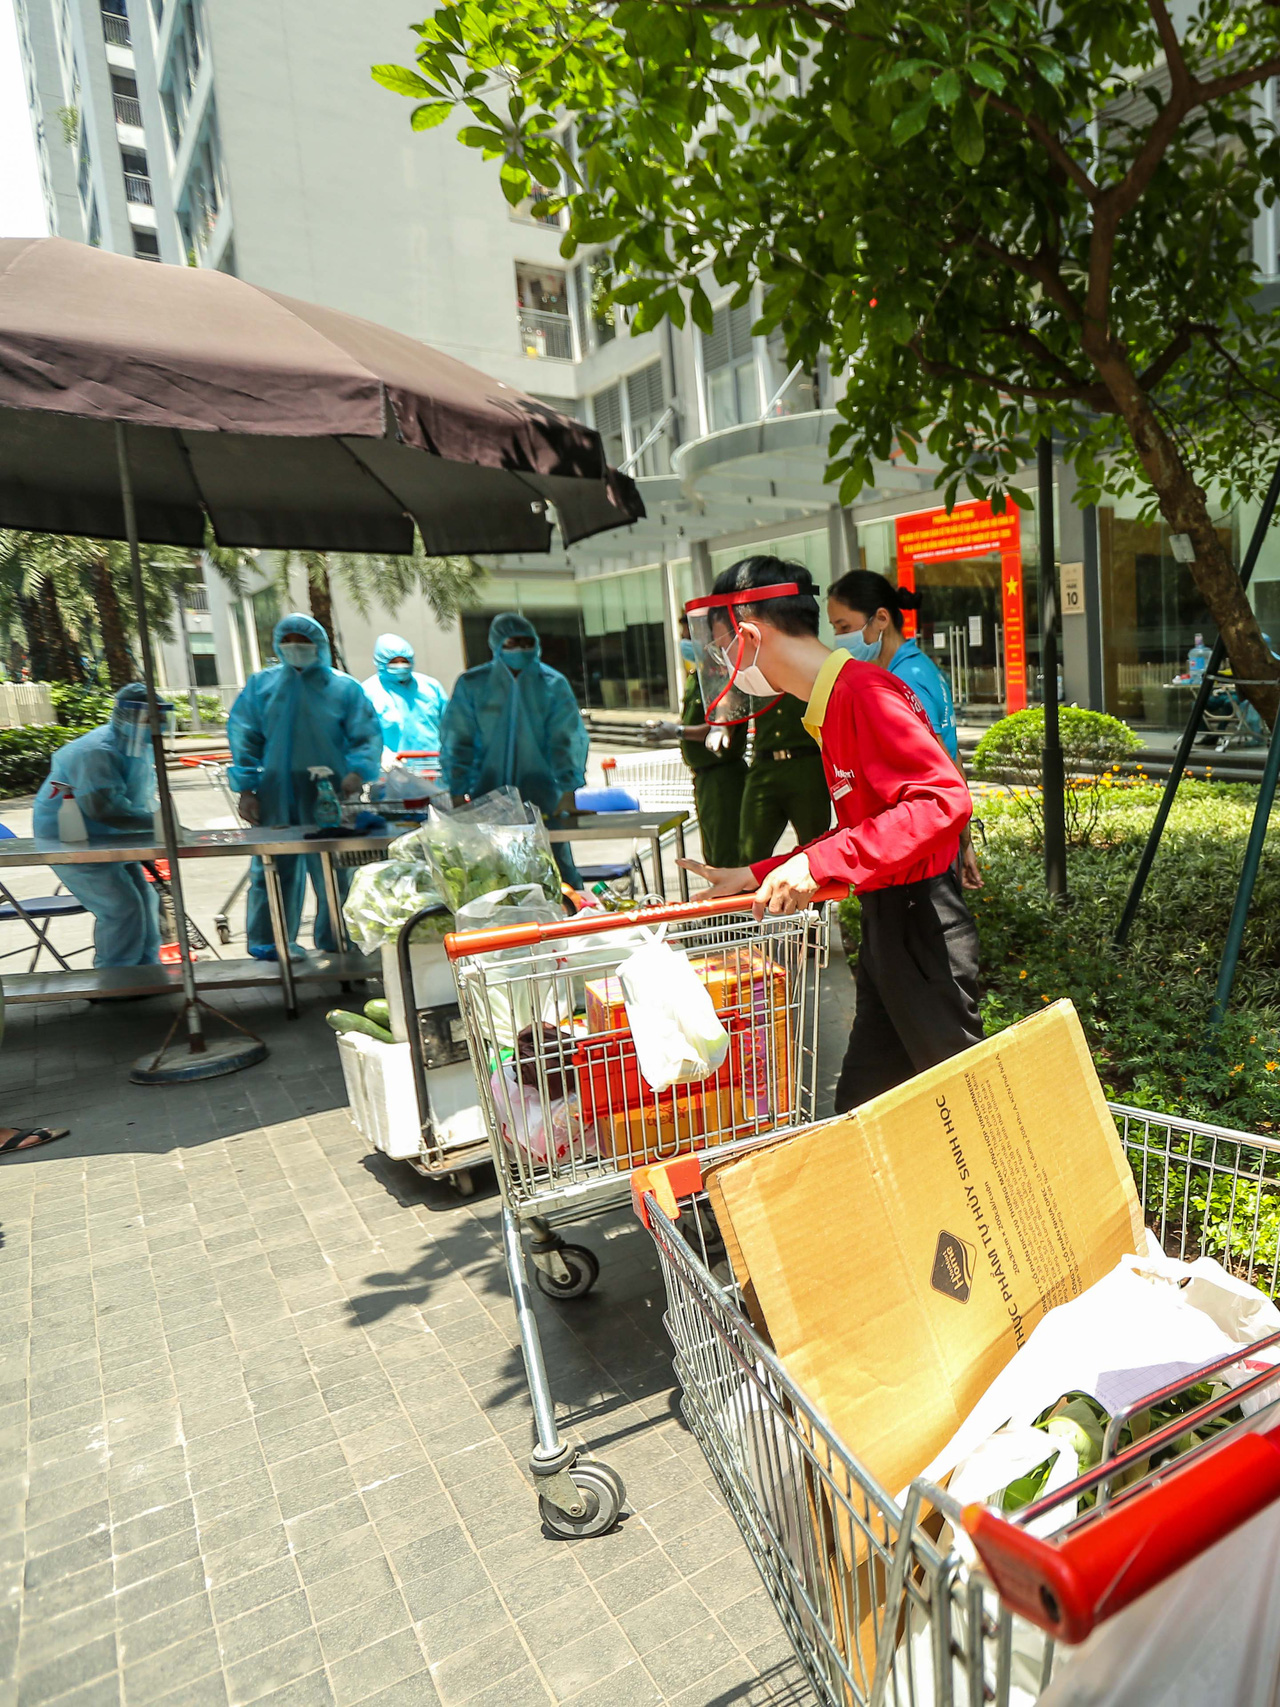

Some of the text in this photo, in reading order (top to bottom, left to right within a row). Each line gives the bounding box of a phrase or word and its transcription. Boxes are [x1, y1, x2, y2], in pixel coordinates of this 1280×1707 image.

[1067, 592, 1078, 605] 10
[963, 1071, 986, 1129] VINCOMMERCE
[1006, 1086, 1015, 1103] KCN
[982, 1129, 992, 1147] HỢP
[1039, 1186, 1051, 1207] OPEC
[934, 1093, 1027, 1350] THỰC PHẨM TỰ HỦY SINH HỌC
[1002, 1237, 1020, 1275] 20x30cm
[945, 1244, 965, 1290] Home
[1067, 1262, 1074, 1273] TY
[1031, 1272, 1039, 1285] CỔ
[1069, 1272, 1078, 1295] CÔNG
[1037, 1284, 1043, 1295] TY
[1040, 1294, 1048, 1314] ÔNG
